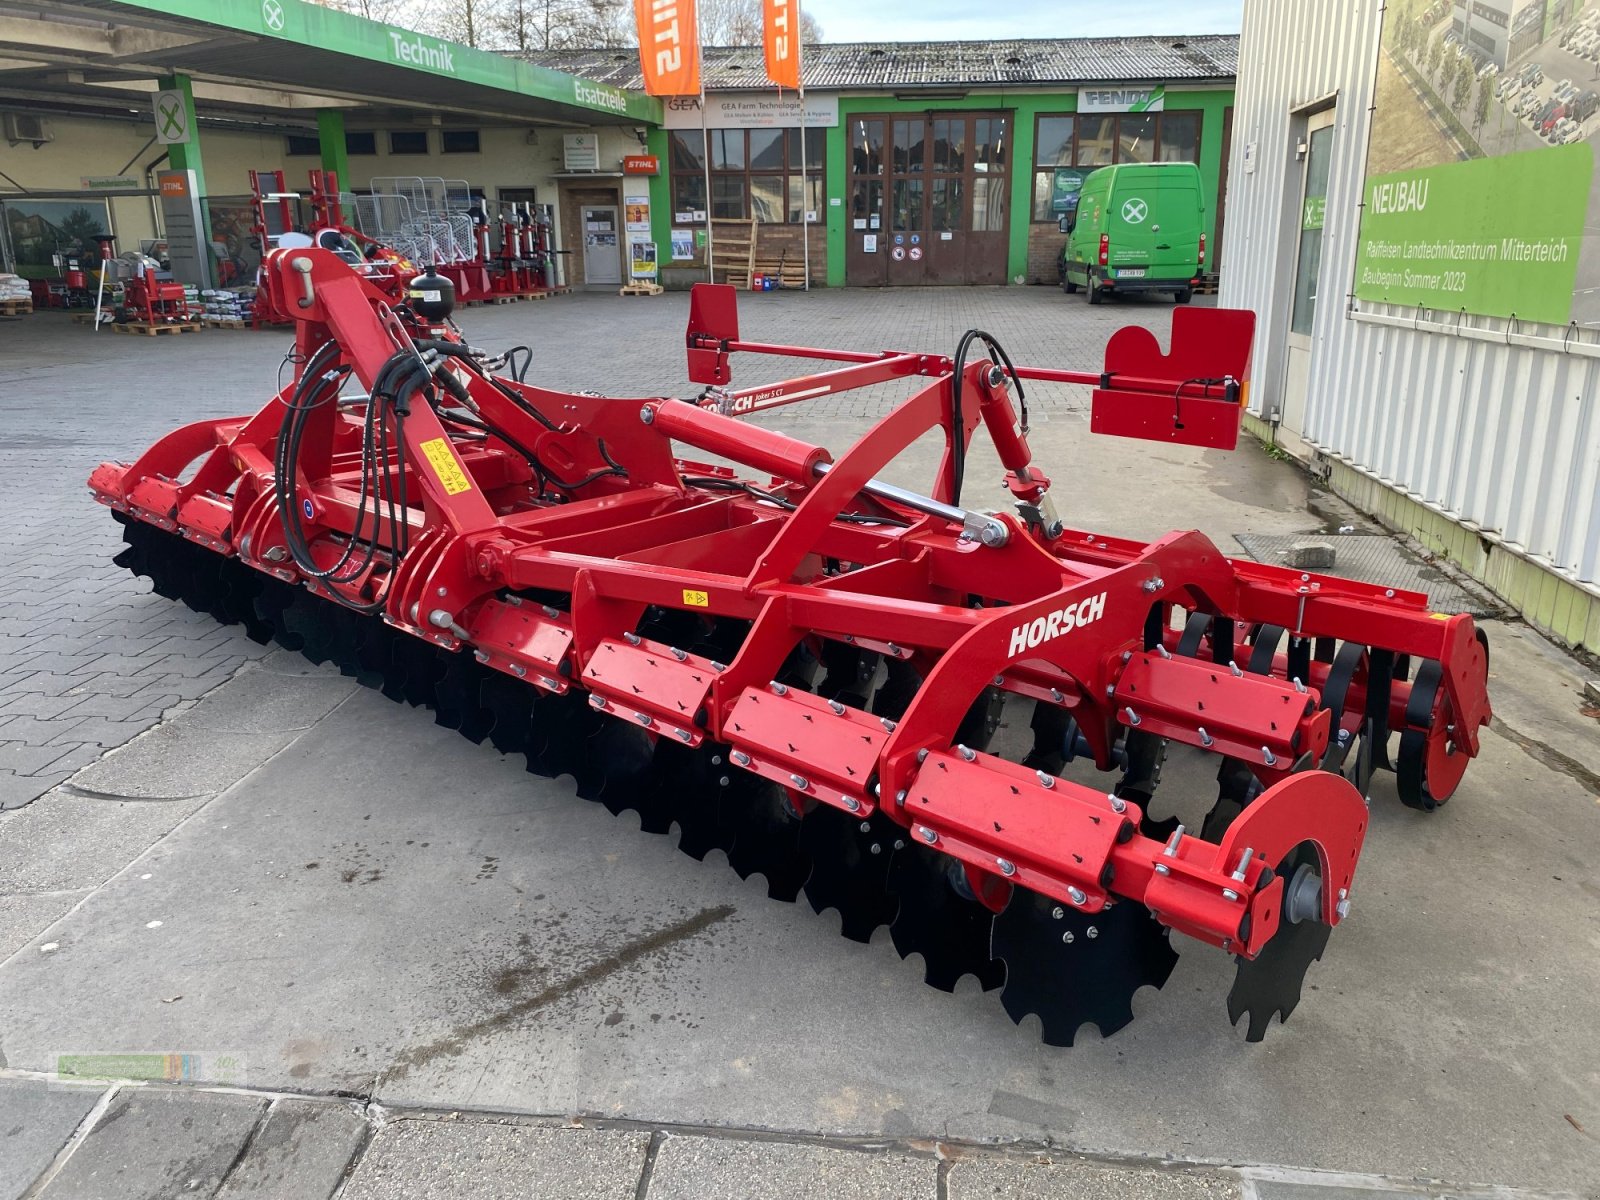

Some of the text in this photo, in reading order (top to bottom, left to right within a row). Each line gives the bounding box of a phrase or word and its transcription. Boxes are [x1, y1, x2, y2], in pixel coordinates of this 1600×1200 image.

[389, 31, 455, 72] Technik
[574, 81, 627, 112] Ersatzteile
[668, 99, 701, 111] GEA
[738, 102, 756, 110] Farm
[1085, 90, 1152, 105] FENDT
[627, 161, 654, 169] STIHL
[163, 182, 183, 191] STIHL
[1371, 178, 1429, 215] NEUBAU
[1366, 237, 1568, 262] Raiffeisen Landtechnikzentrum Mitterteich
[1361, 267, 1467, 292] Baubeginn Sommer 2023
[1008, 592, 1107, 658] HORSCH
